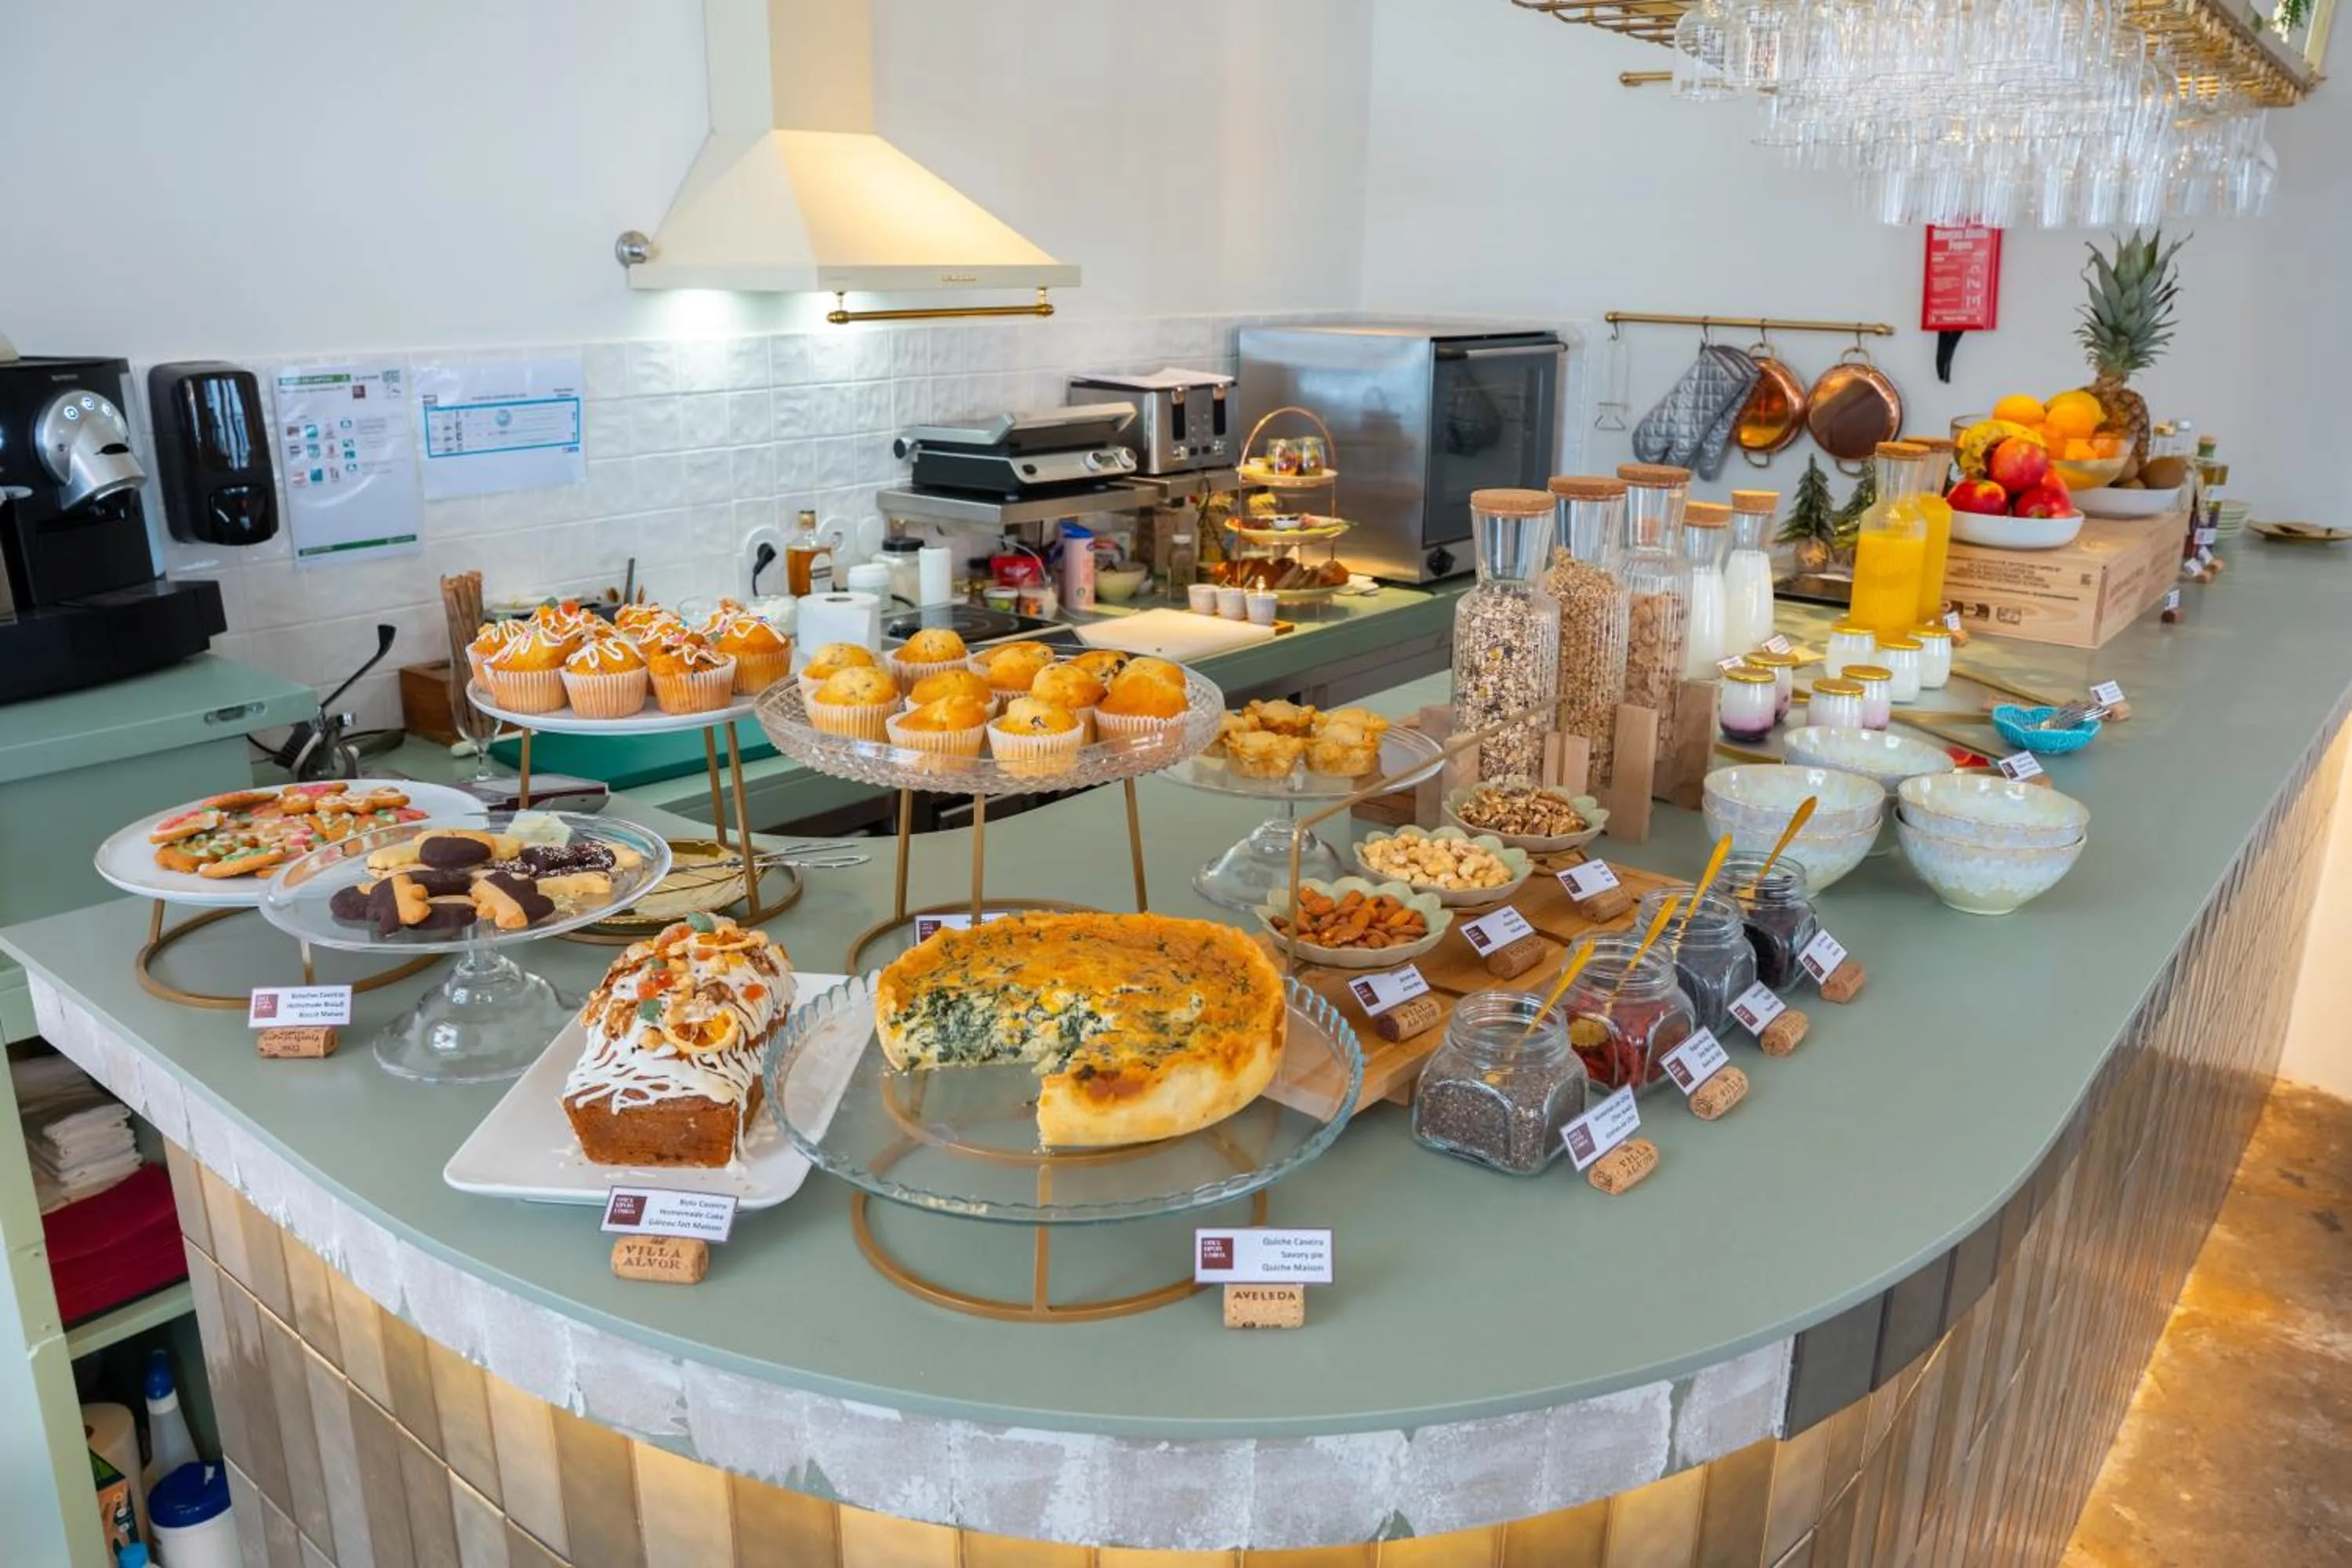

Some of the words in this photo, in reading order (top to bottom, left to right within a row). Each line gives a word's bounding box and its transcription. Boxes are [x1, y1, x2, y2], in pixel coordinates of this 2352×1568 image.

[1262, 1236, 1292, 1247] Quiche
[1294, 1236, 1325, 1247] Caseira
[625, 1245, 683, 1259] VILLA
[1280, 1250, 1309, 1260] Savory
[1311, 1251, 1324, 1260] pie
[623, 1257, 681, 1270] ALVOR
[1261, 1263, 1291, 1272] Quiche
[1294, 1263, 1325, 1272] Maison
[1233, 1290, 1297, 1301] AVELEDA
